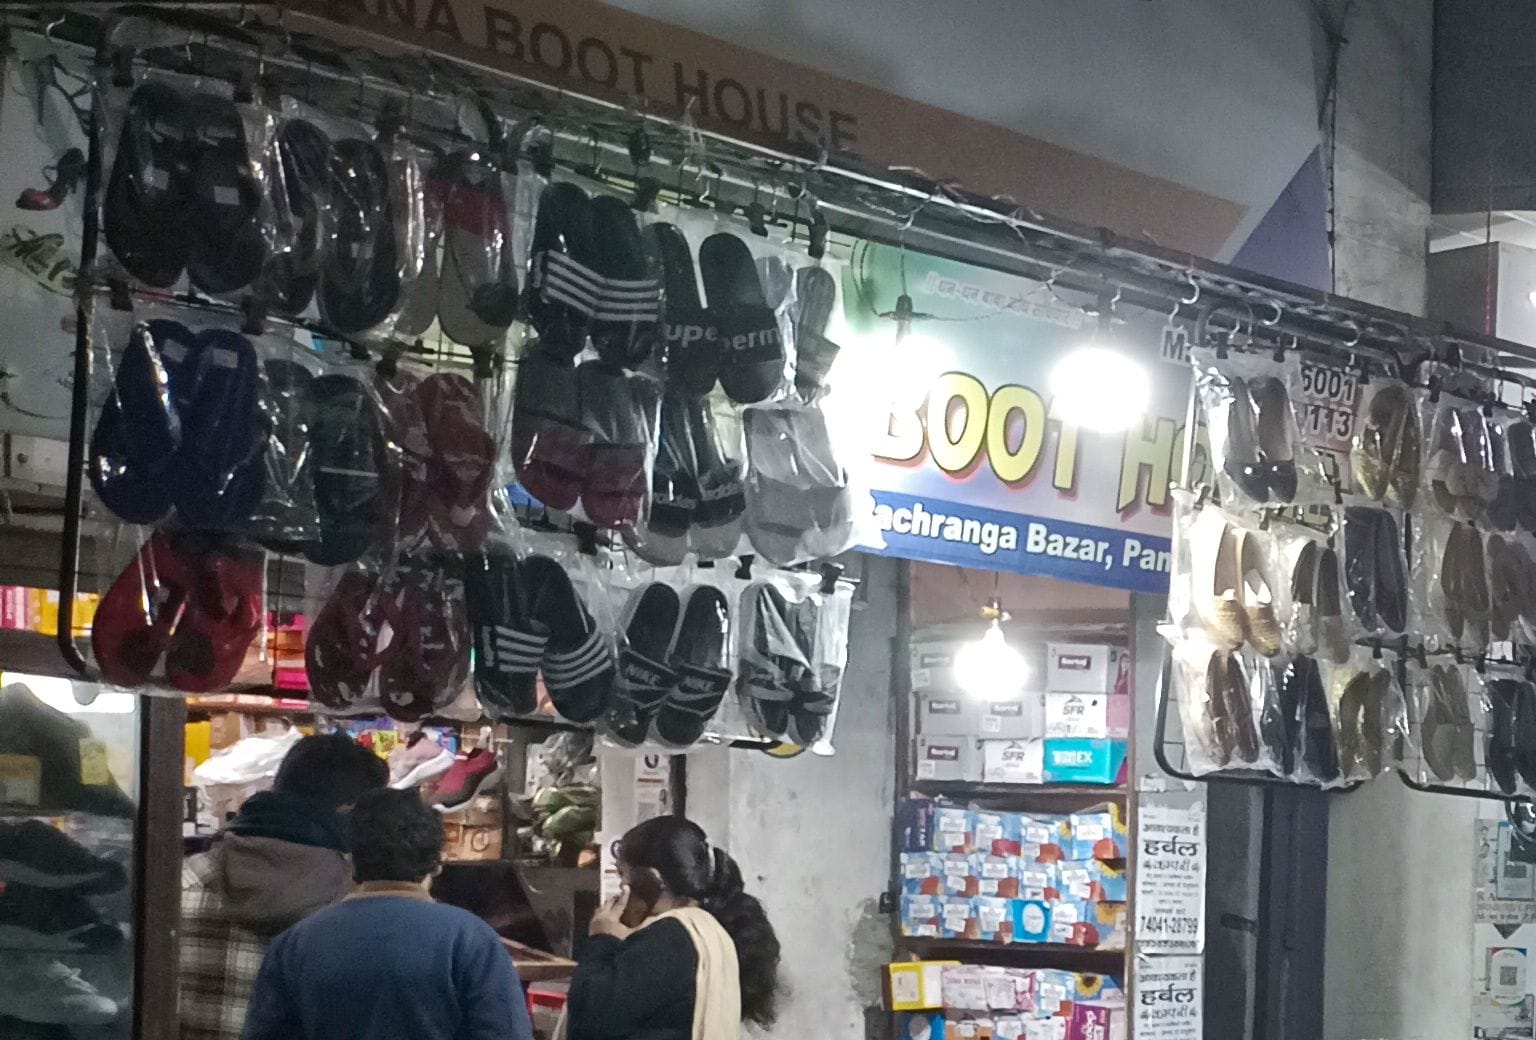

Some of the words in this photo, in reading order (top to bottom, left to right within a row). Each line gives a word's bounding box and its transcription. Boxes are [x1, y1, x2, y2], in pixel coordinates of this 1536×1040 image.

[485, 5, 655, 97] BOOT
[674, 60, 858, 152] HOUSE
[1026, 521, 1113, 572] Bazar,
